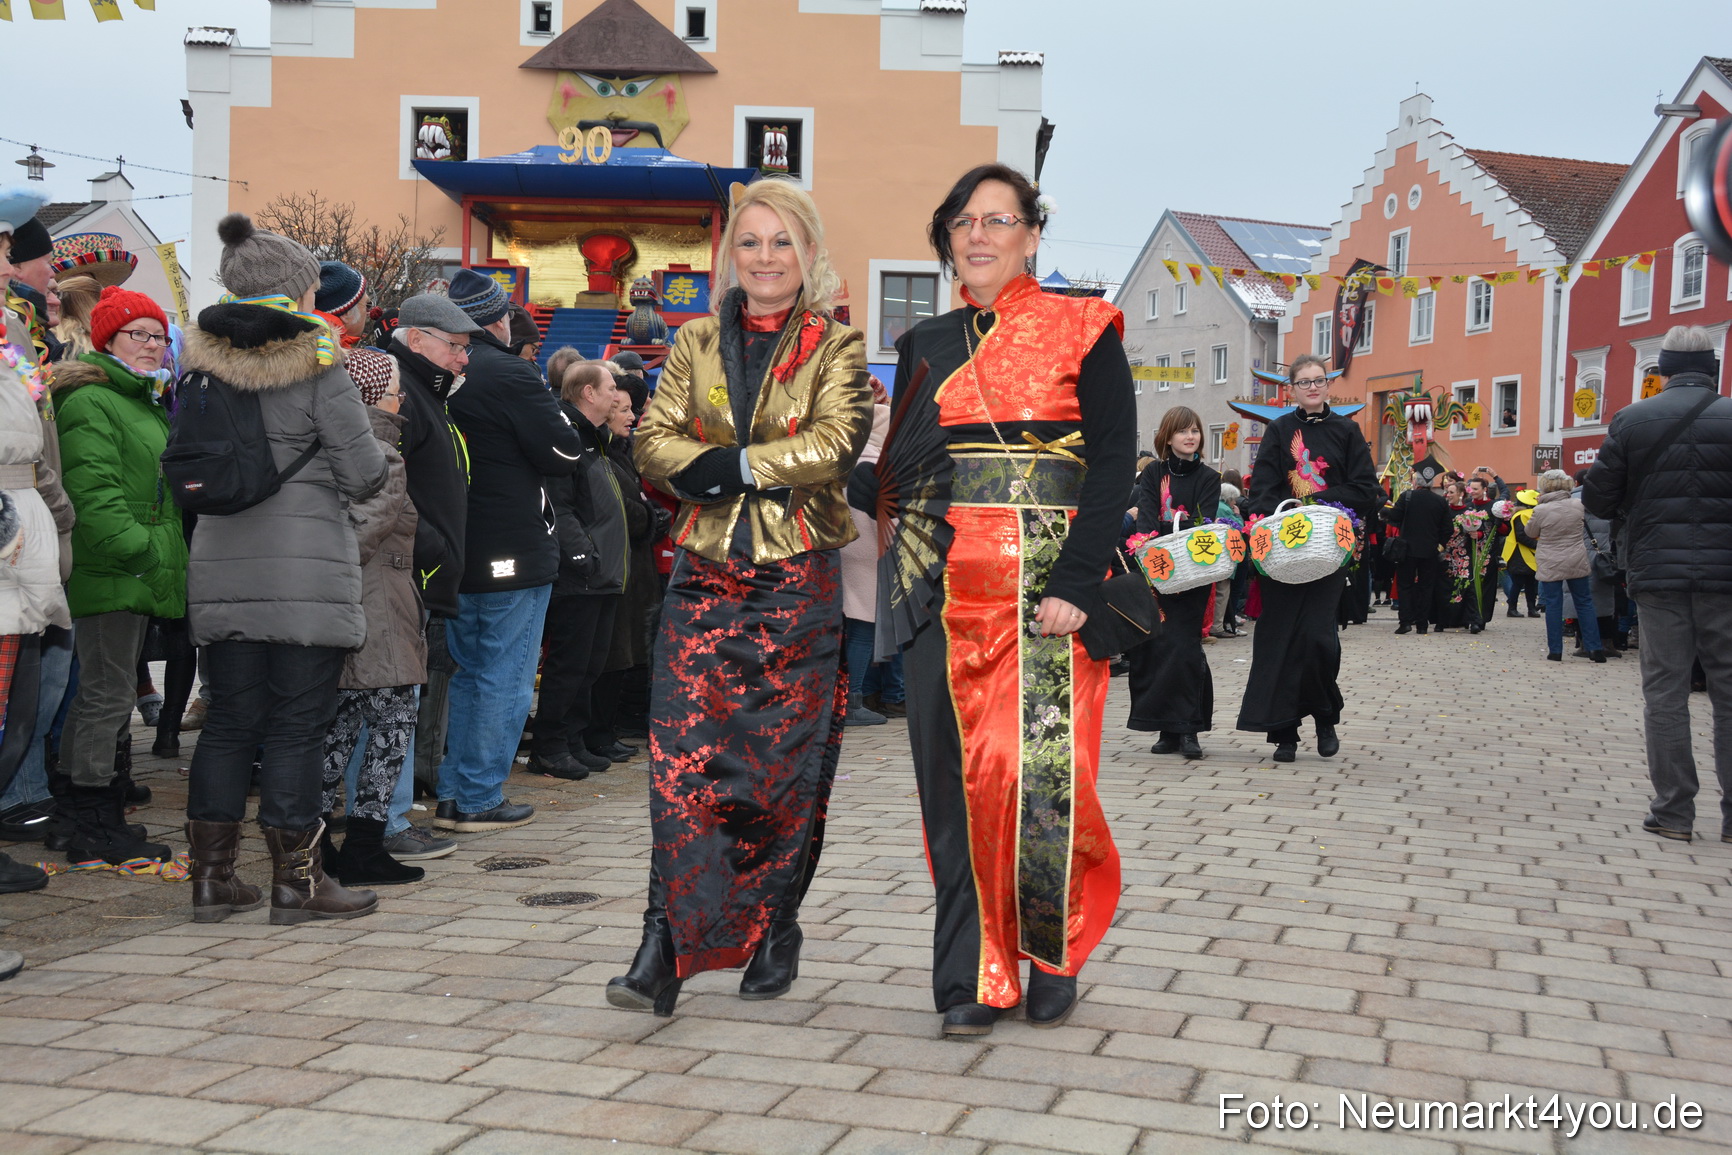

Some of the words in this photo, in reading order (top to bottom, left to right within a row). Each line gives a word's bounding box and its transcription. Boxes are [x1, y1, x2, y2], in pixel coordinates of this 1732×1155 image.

[558, 126, 612, 163] 90
[1536, 447, 1558, 459] CAFÉ
[1286, 519, 1306, 545] 受
[1194, 535, 1216, 556] 受
